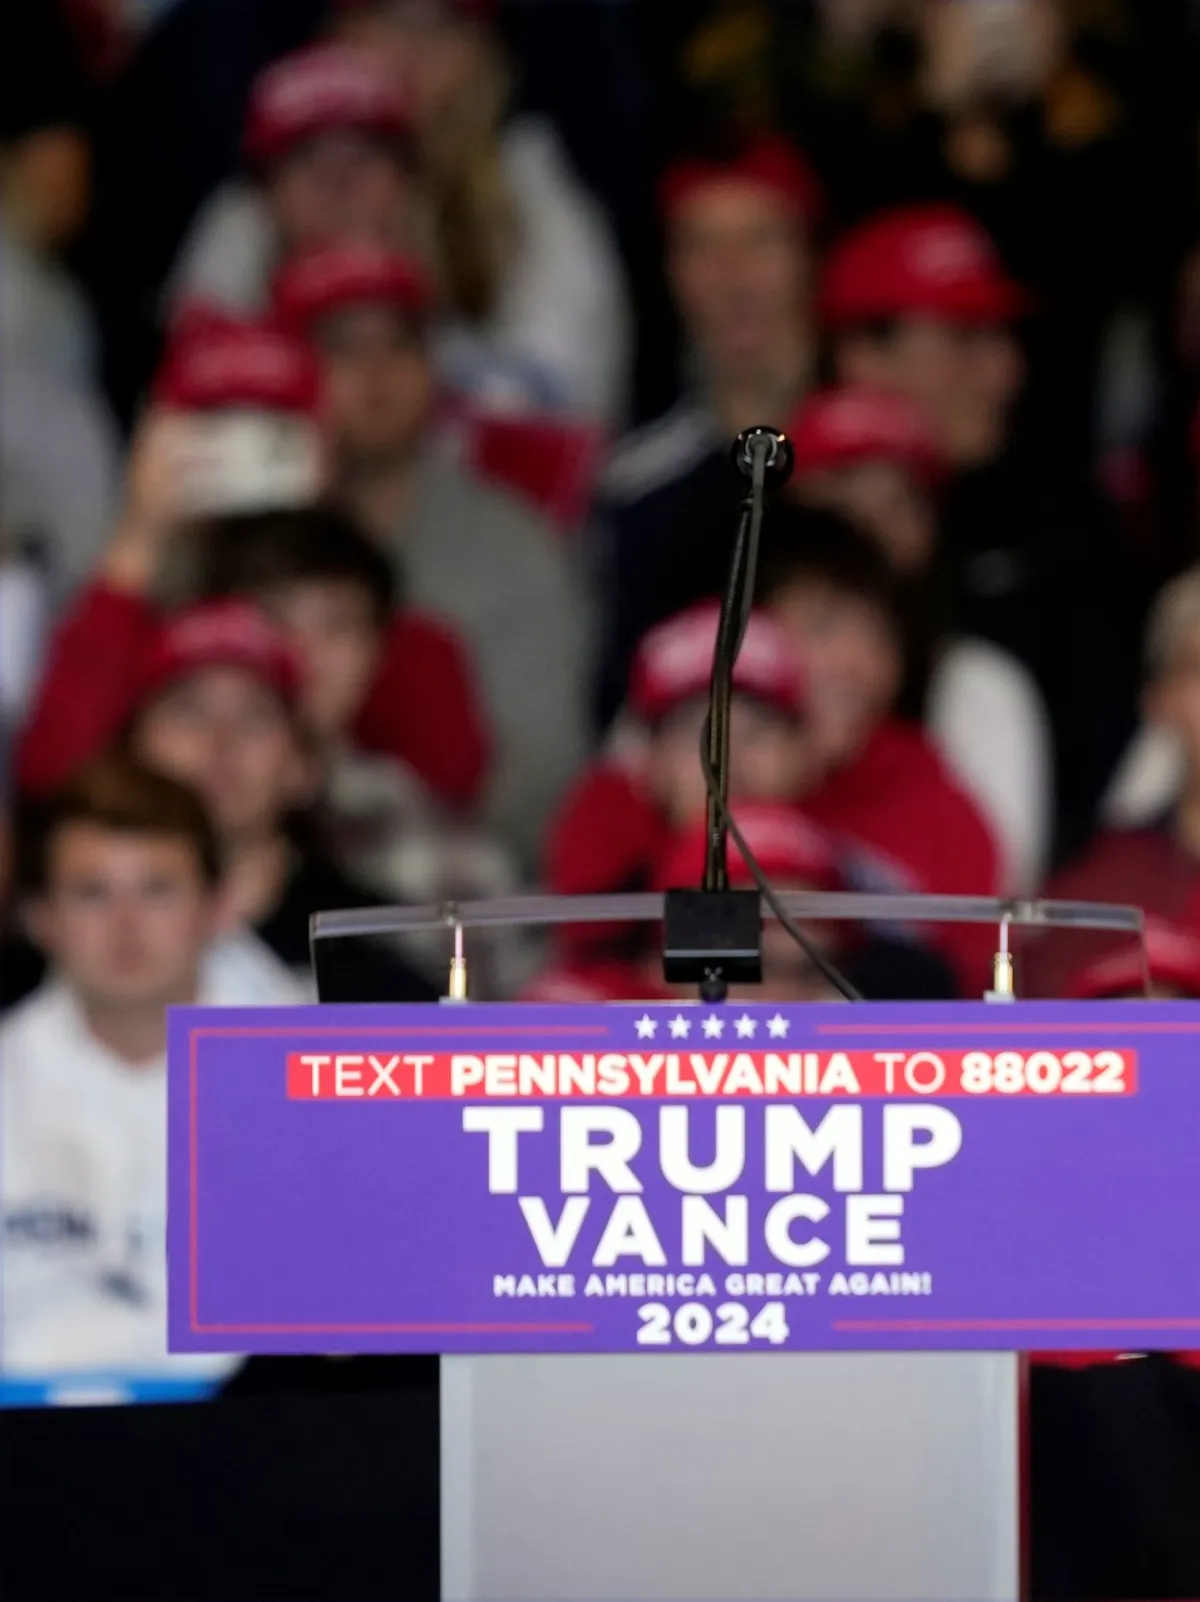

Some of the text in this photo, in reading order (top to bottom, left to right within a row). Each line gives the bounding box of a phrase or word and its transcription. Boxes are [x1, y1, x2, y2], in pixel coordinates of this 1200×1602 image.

[300, 1051, 1124, 1096] TEXT PENNSYLVANIA TO 88022
[462, 1104, 962, 1194] TRUMP
[518, 1193, 905, 1267] VANCE
[494, 1273, 932, 1297] MAKE AMERICA GREAT AGAIN!
[636, 1302, 790, 1345] 2024
